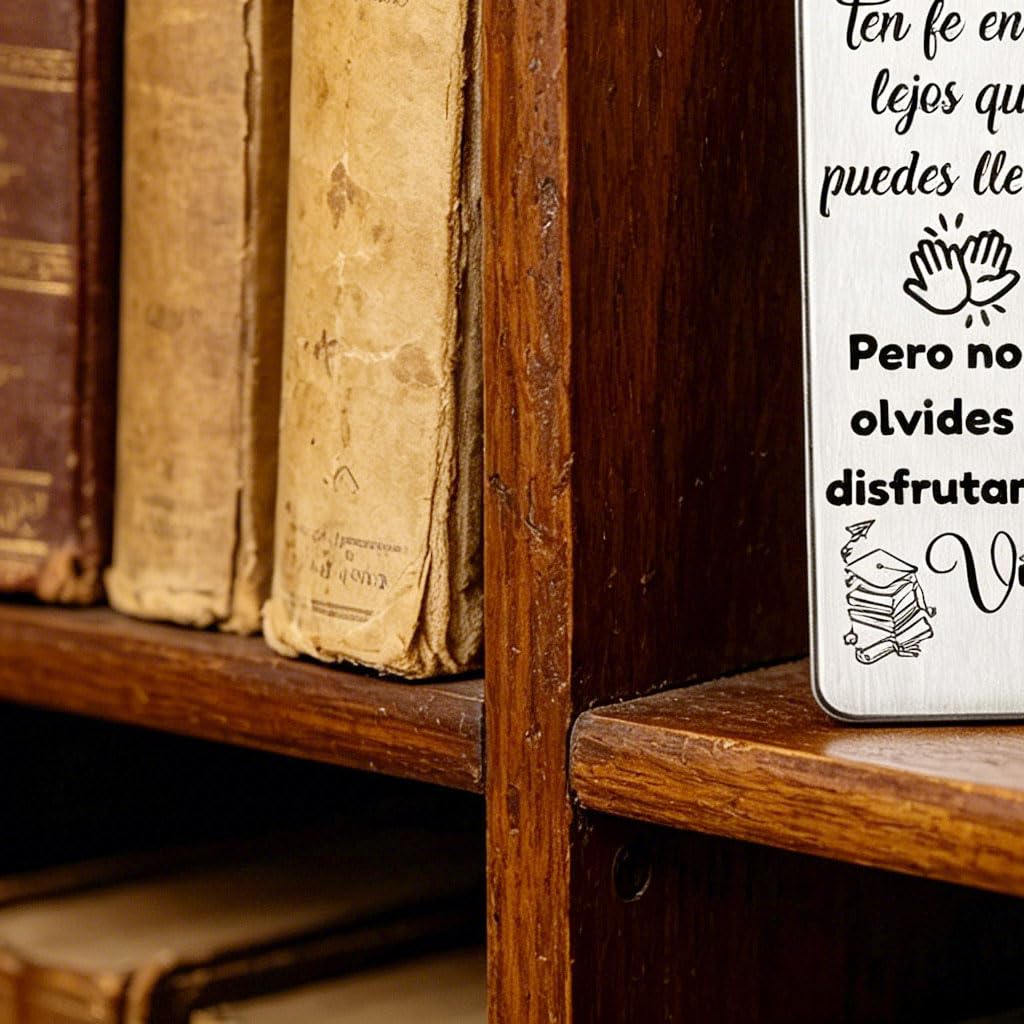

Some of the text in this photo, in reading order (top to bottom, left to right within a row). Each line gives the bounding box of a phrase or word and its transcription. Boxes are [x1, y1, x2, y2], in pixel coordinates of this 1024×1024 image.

[870, 68, 964, 136] lejos
[819, 150, 961, 219] puedes
[849, 333, 955, 371] Pero
[967, 342, 1023, 371] no
[850, 397, 1014, 437] olvides
